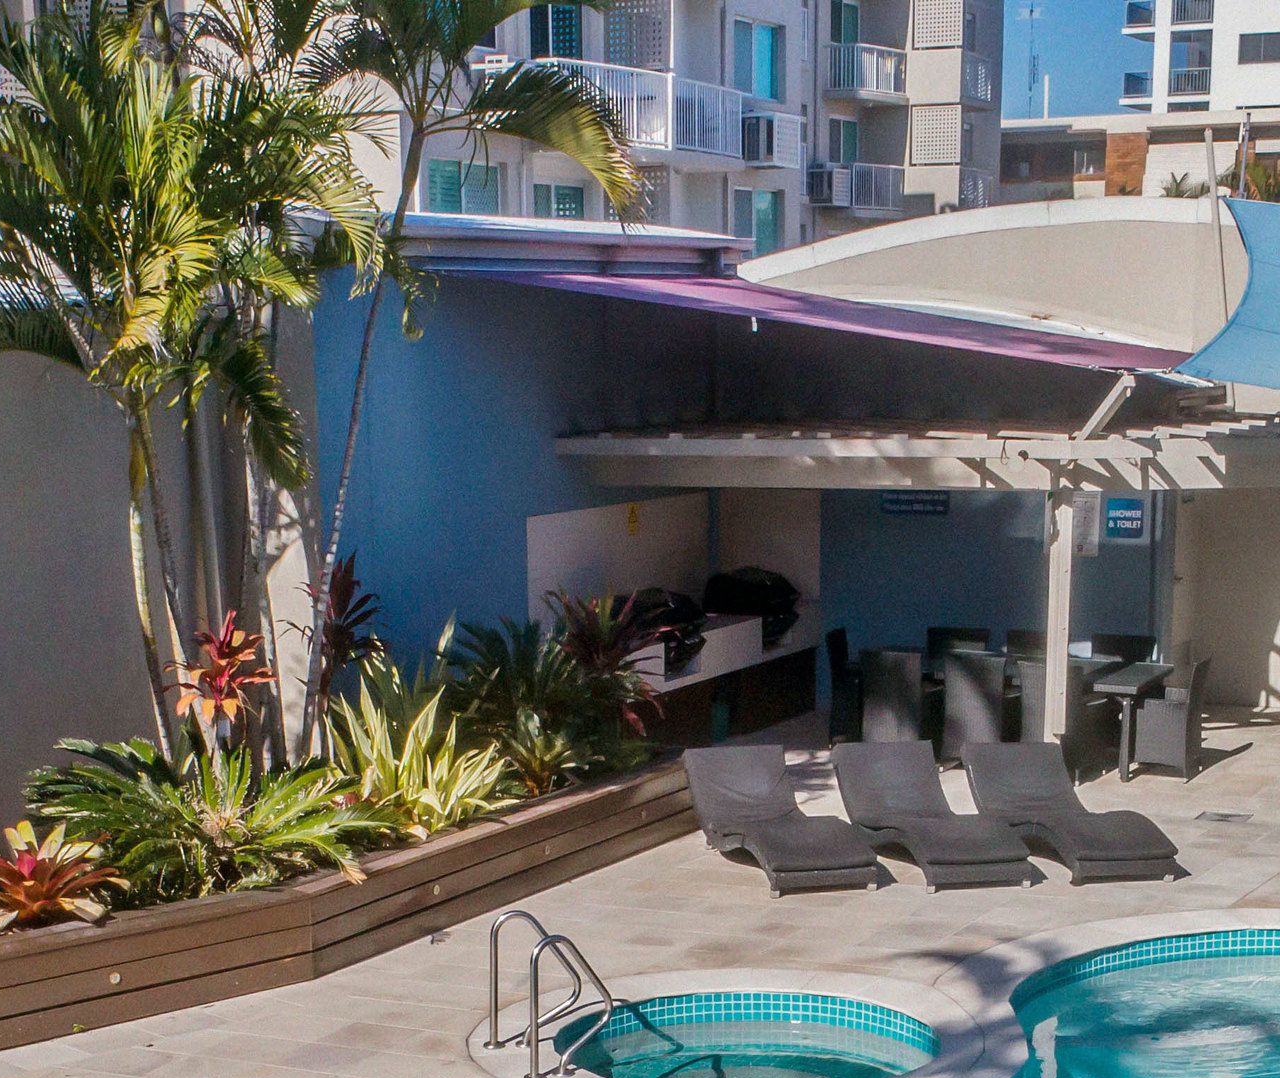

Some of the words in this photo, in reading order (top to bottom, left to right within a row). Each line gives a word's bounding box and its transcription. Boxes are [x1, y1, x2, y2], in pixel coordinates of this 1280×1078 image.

[1108, 510, 1142, 518] SHOWER
[1108, 520, 1114, 528] &
[1117, 520, 1141, 528] TOILET
